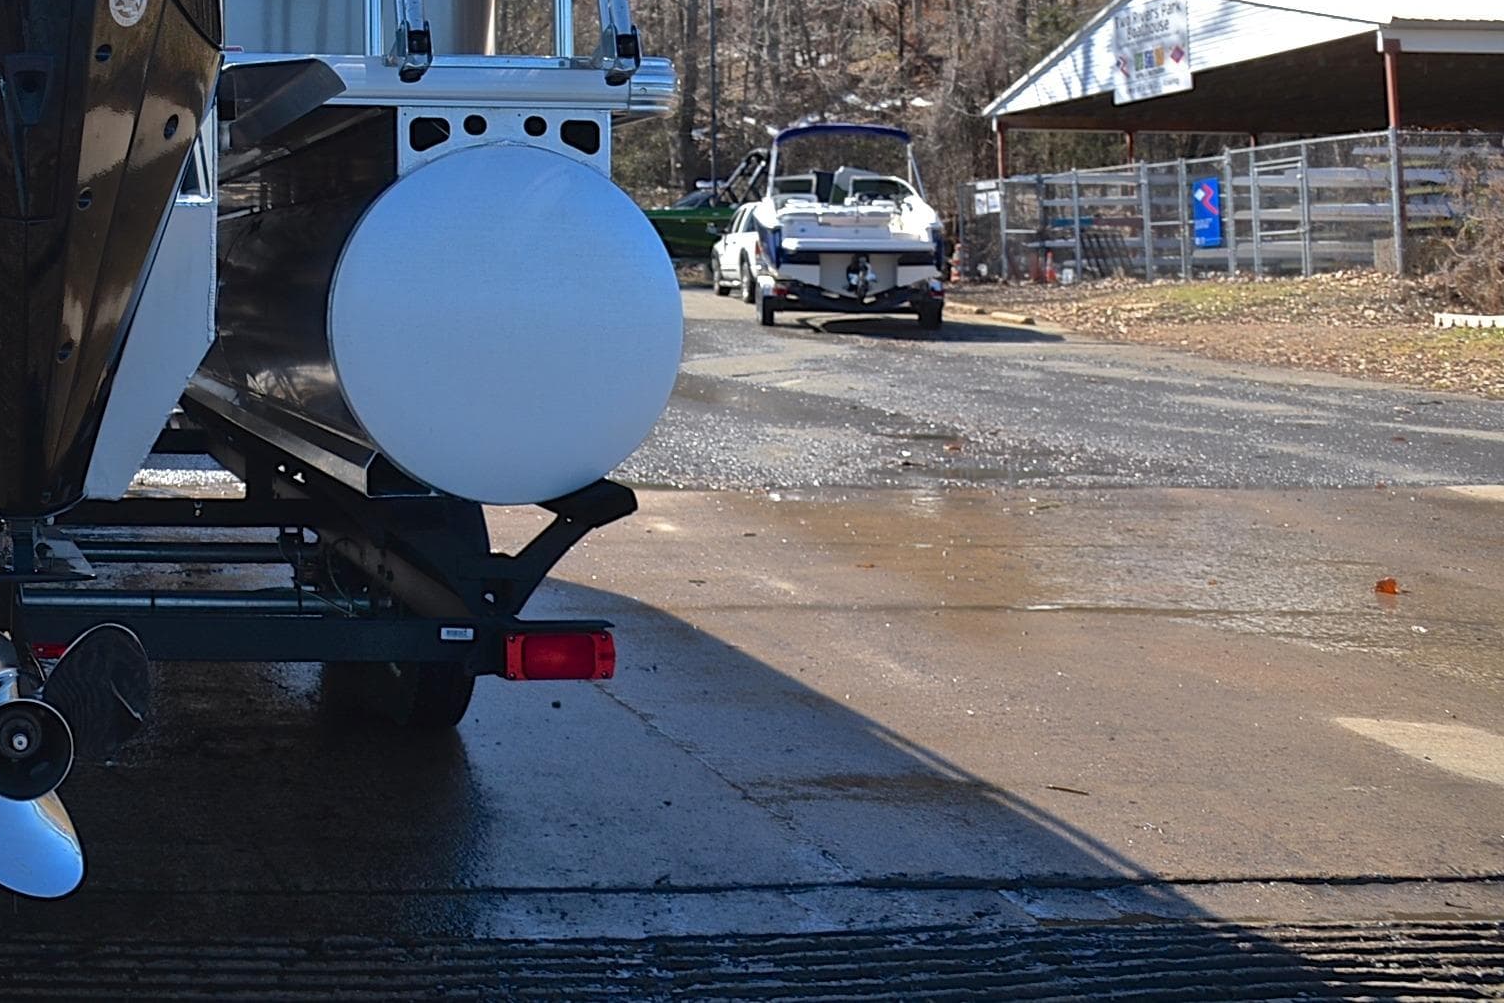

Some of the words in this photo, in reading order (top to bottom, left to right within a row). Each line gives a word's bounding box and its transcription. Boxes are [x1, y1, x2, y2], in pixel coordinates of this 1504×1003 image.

[1115, 16, 1131, 30] Two
[1133, 8, 1159, 23] Rivers
[1161, 1, 1182, 16] Park
[1127, 19, 1169, 40] Boathouse
